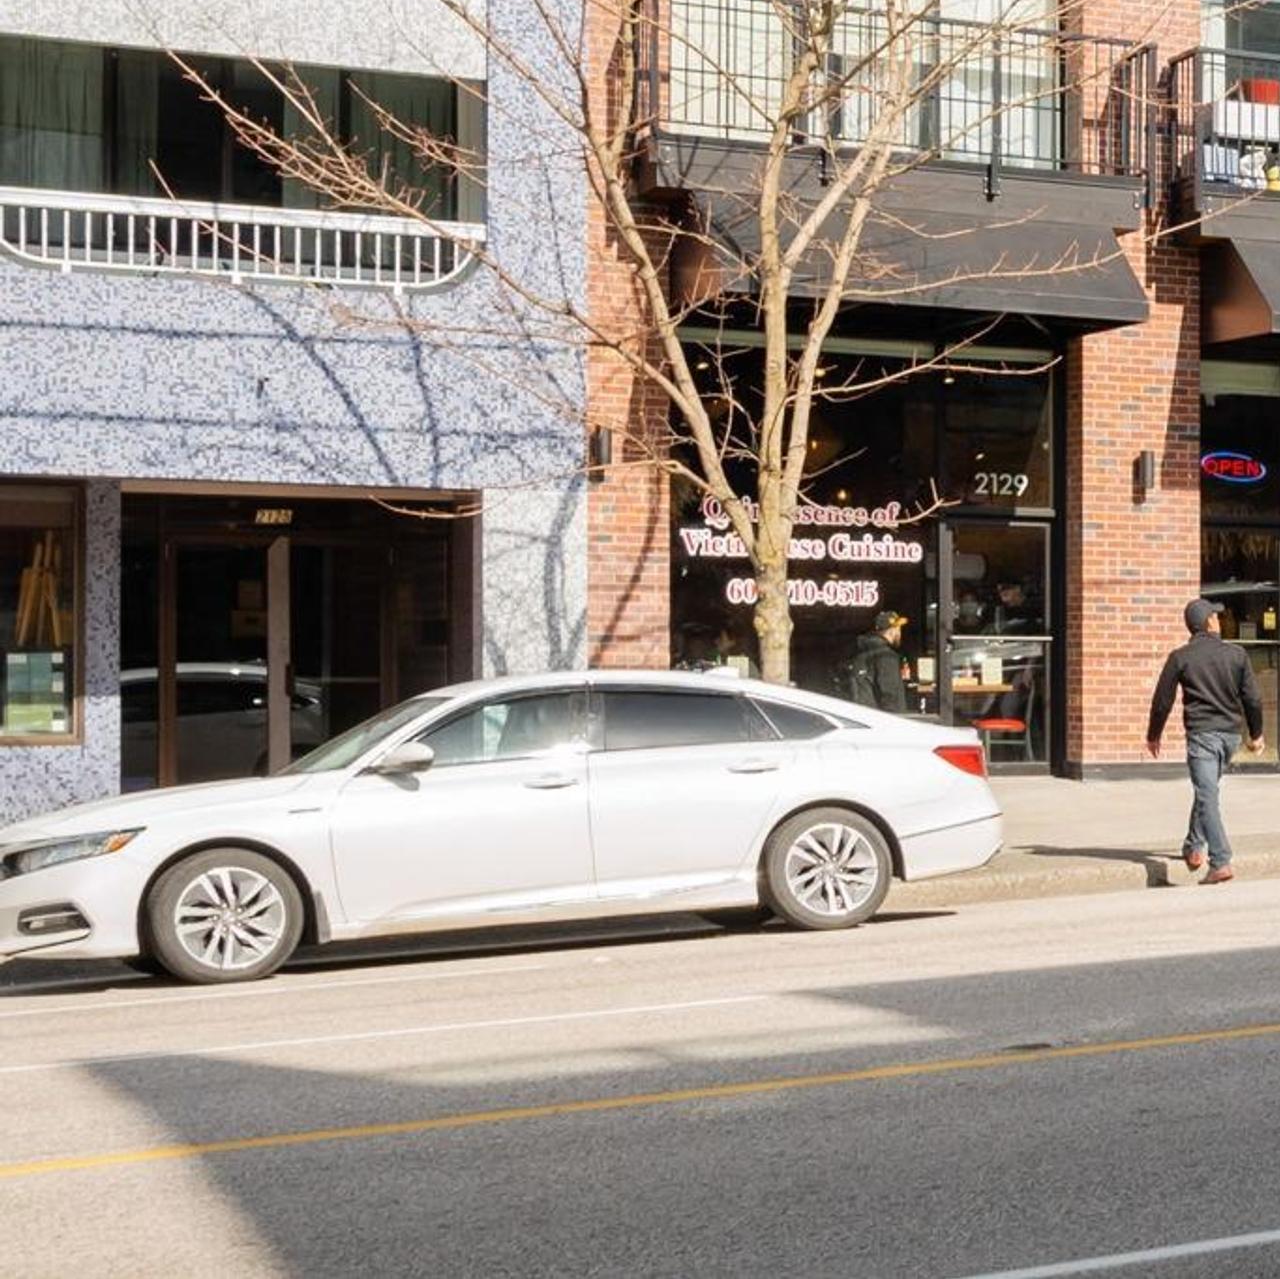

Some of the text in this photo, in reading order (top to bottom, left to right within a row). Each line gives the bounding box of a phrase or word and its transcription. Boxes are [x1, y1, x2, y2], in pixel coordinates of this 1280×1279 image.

[1203, 459, 1260, 477] OPEN
[974, 472, 1029, 496] 2129
[871, 501, 901, 528] of
[680, 528, 923, 562] Vietnese Cuisine
